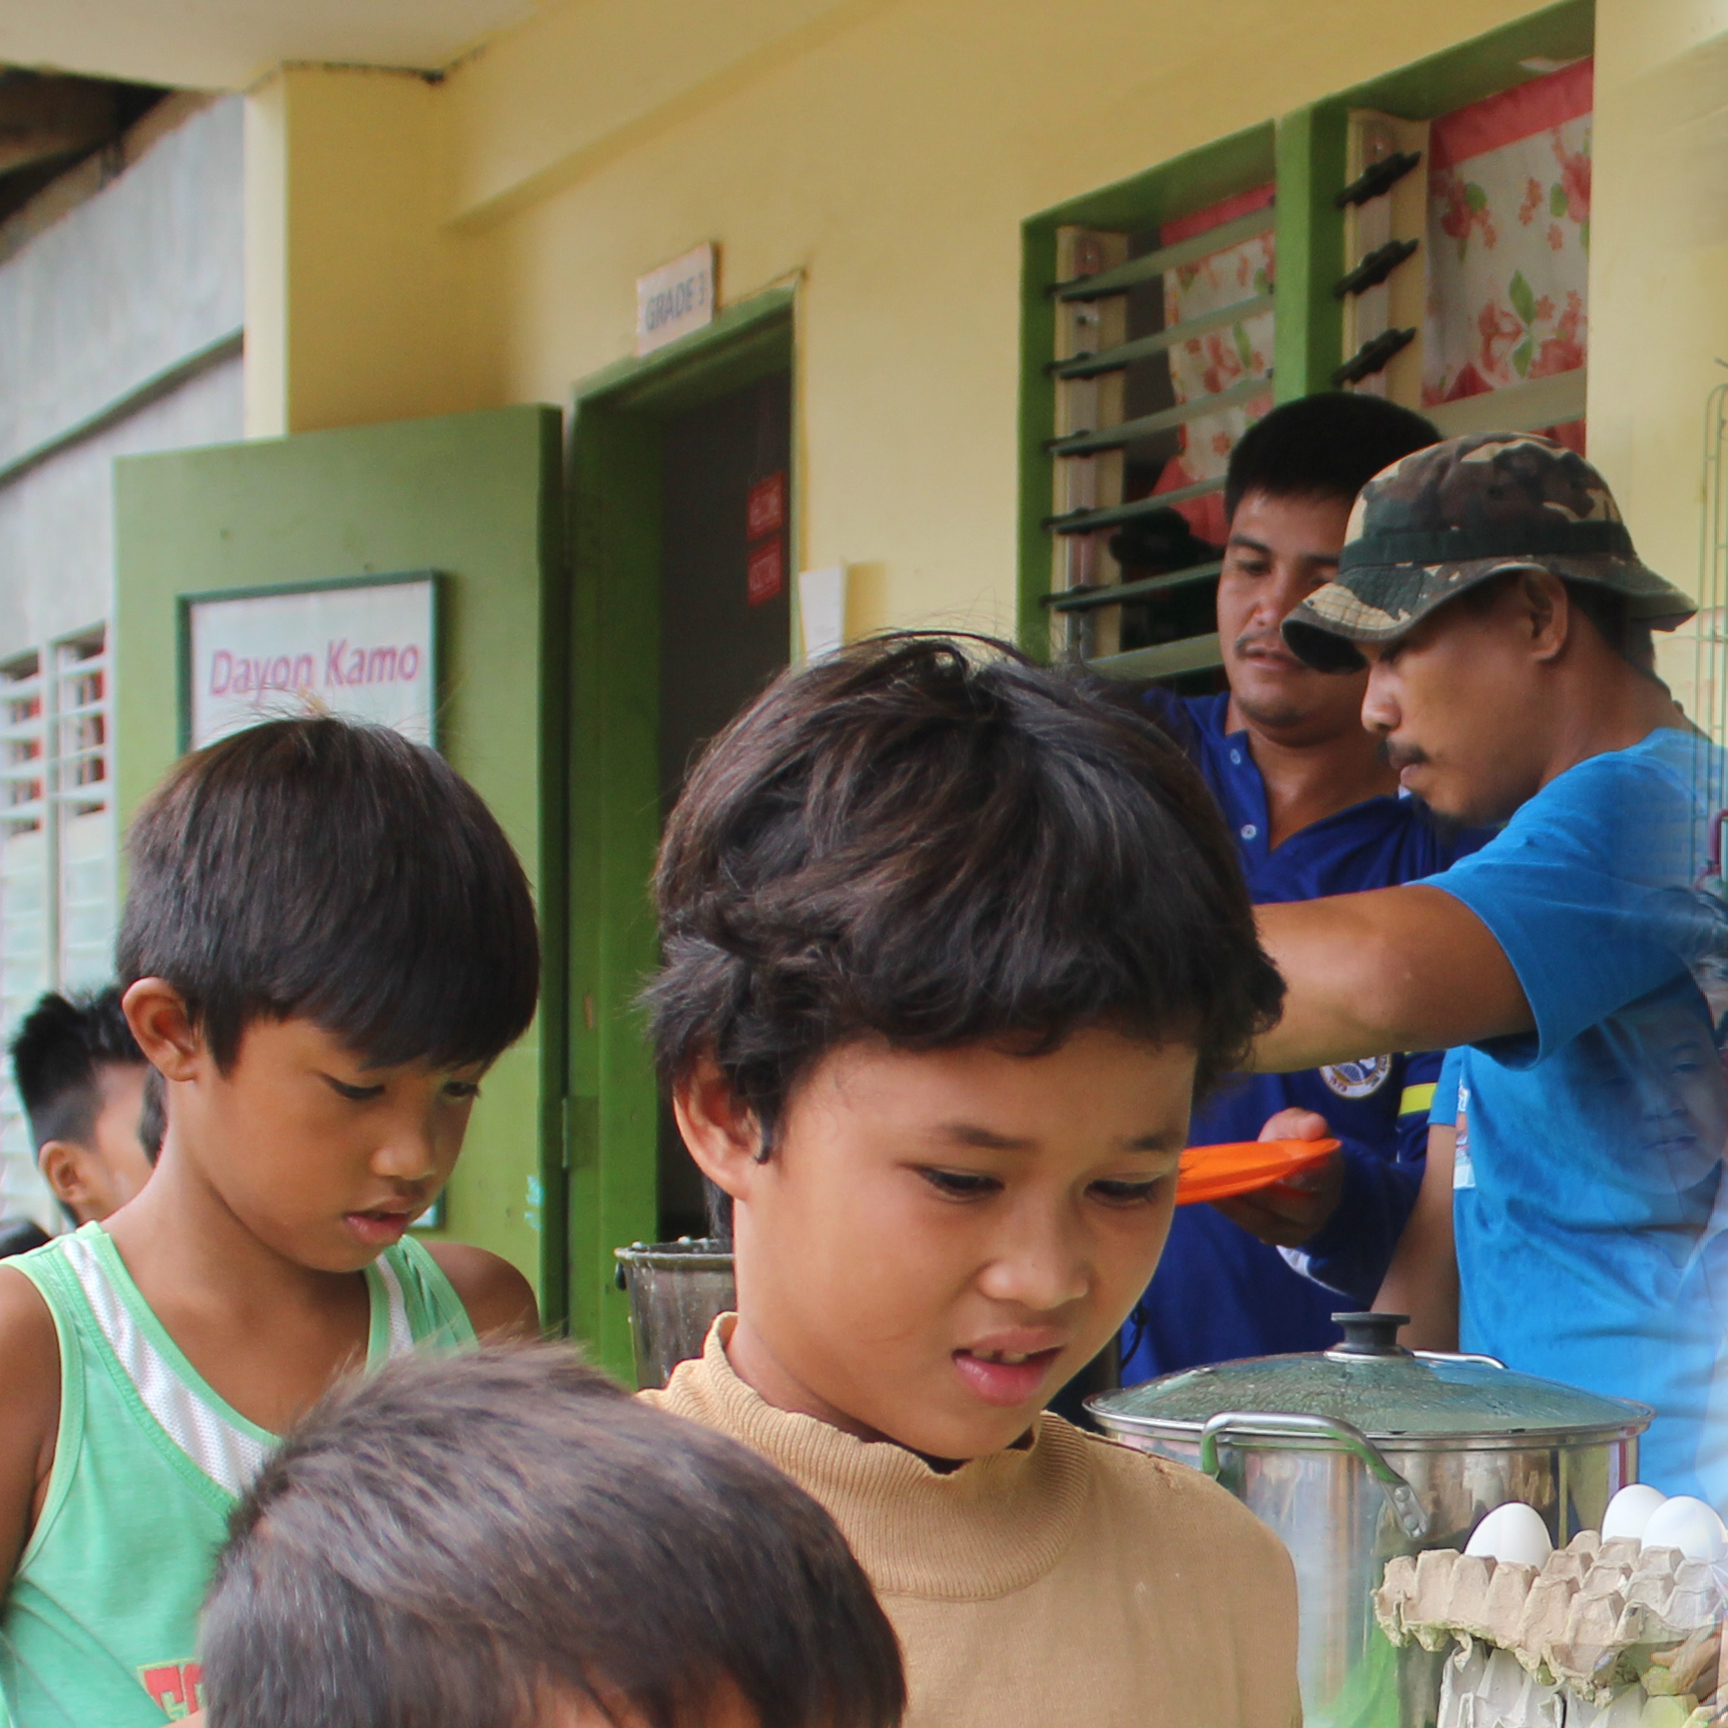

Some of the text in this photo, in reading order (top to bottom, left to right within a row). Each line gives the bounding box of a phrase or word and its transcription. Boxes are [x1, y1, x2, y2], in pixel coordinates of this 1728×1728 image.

[645, 276, 694, 330] GRADE
[210, 639, 421, 705] Dayon Kamo
